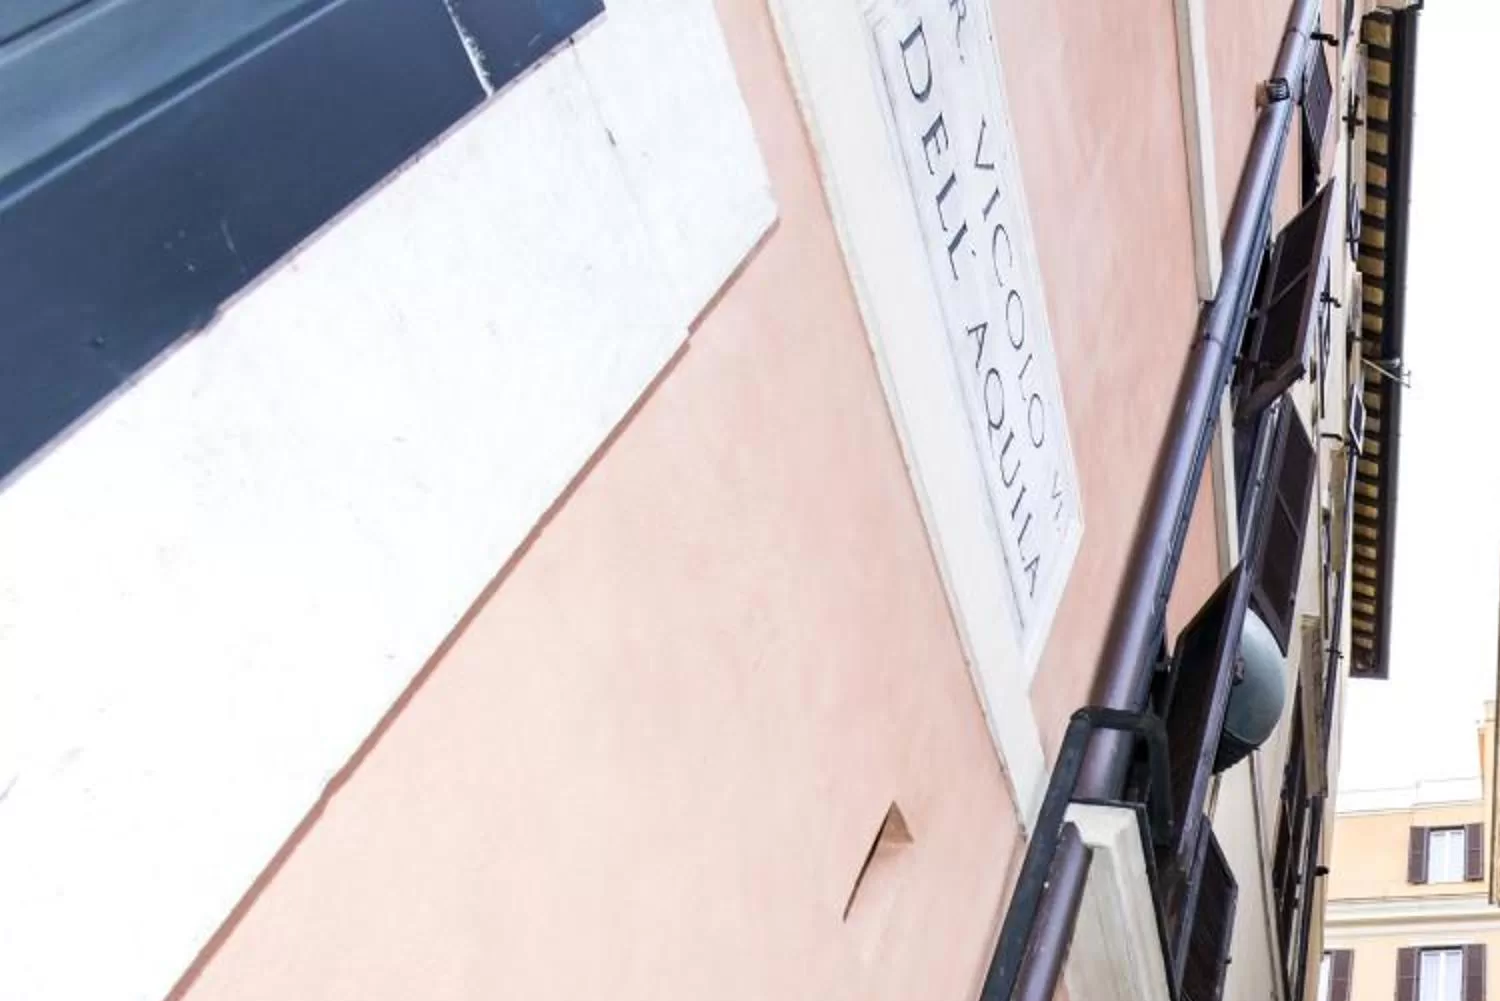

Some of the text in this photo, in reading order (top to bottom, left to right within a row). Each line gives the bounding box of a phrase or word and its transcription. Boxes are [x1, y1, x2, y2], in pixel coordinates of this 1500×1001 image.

[898, 16, 1041, 598] DELL' AQUILA
[973, 113, 1046, 449] VICOLO
